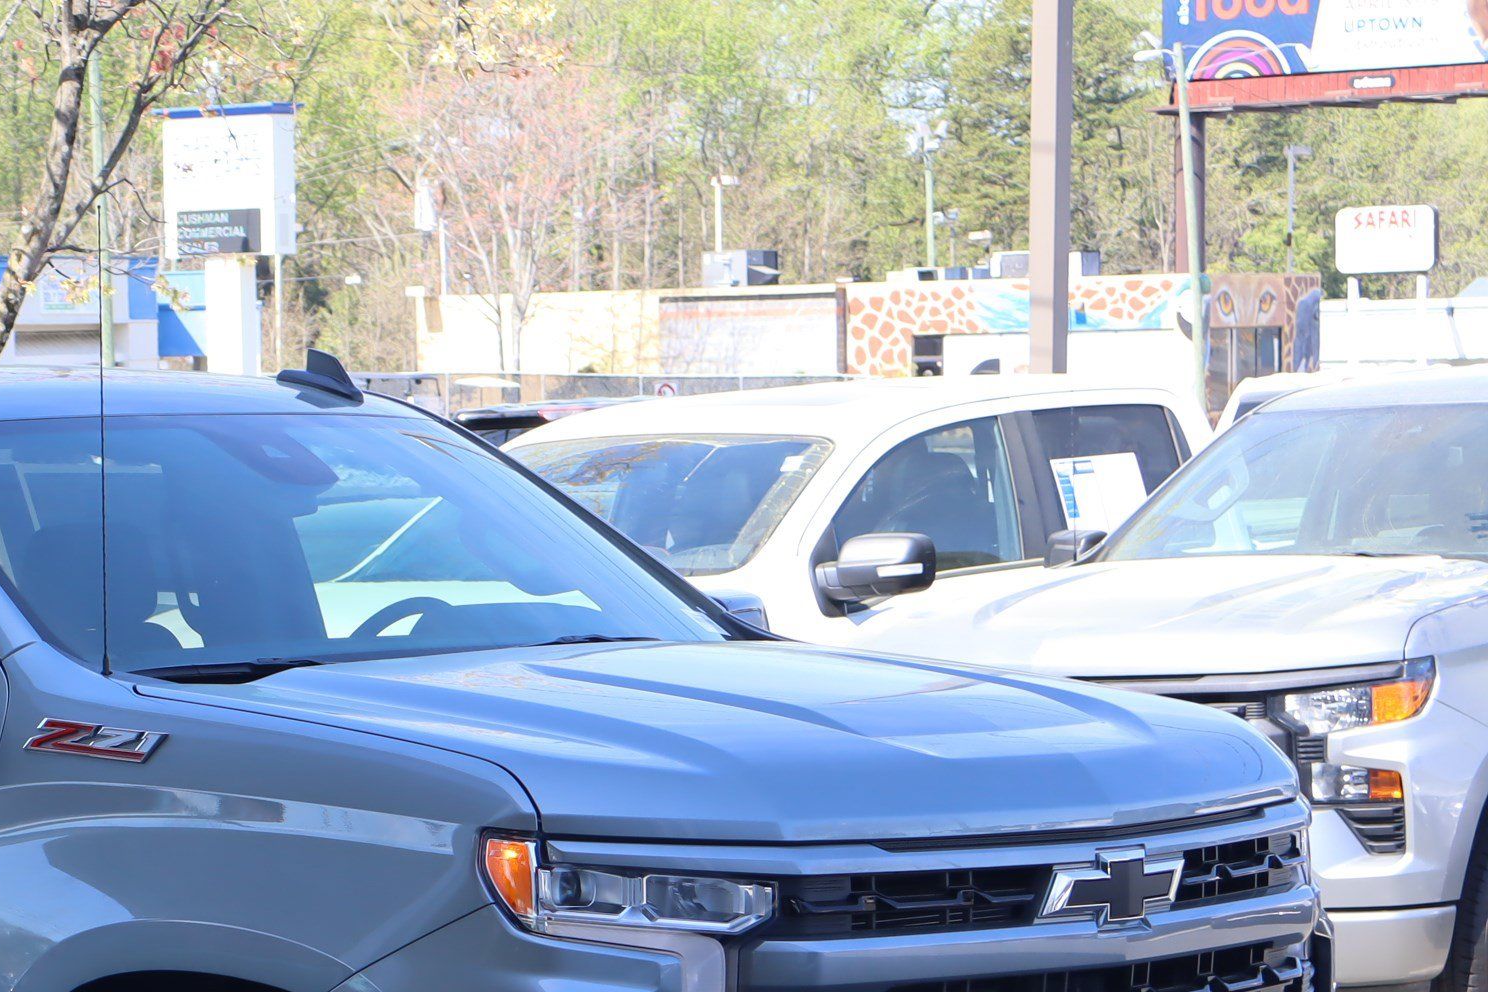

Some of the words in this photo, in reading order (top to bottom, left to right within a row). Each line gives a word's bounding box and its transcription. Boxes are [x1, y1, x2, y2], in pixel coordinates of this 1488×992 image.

[1344, 16, 1423, 33] UPTOWN
[1354, 209, 1416, 229] SAFARI
[23, 717, 170, 763] Z71
